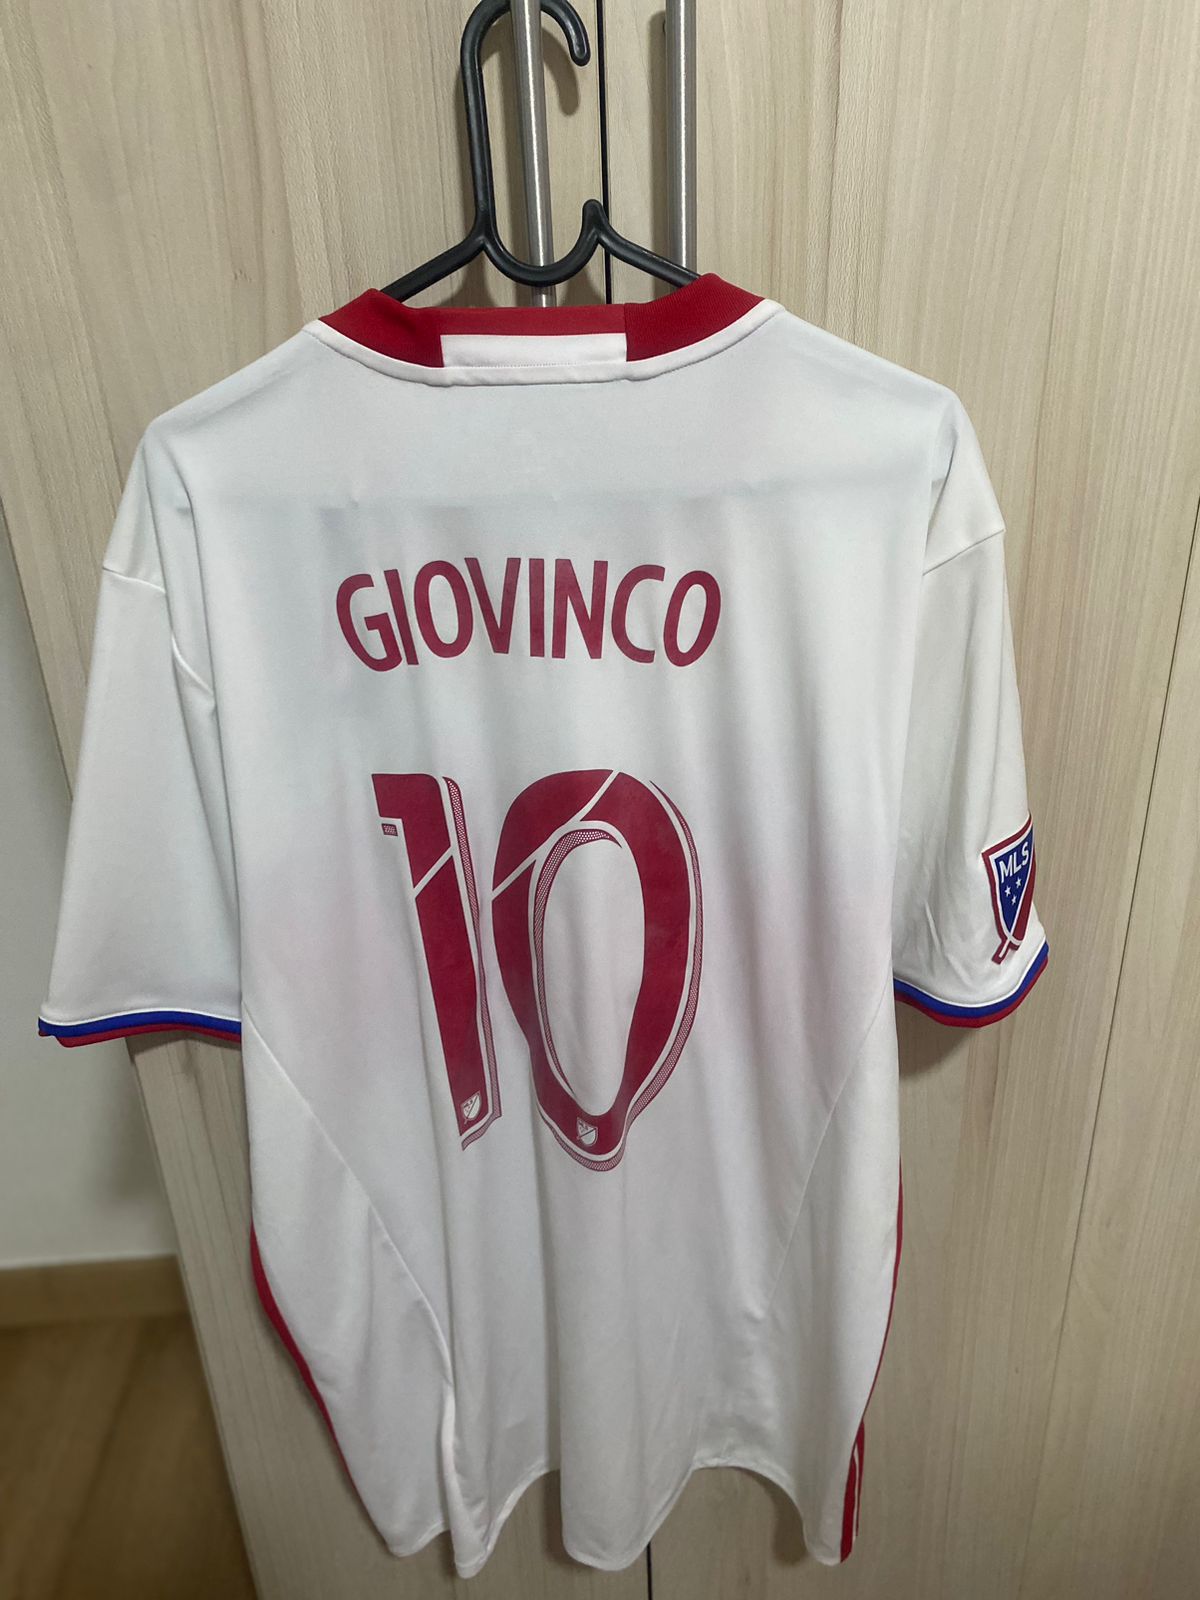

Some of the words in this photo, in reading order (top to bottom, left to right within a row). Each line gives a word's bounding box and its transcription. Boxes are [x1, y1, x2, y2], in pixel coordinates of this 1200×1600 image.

[336, 557, 722, 672] GIOVINCO
[999, 841, 1030, 883] MLS
[371, 769, 704, 1171] 10
